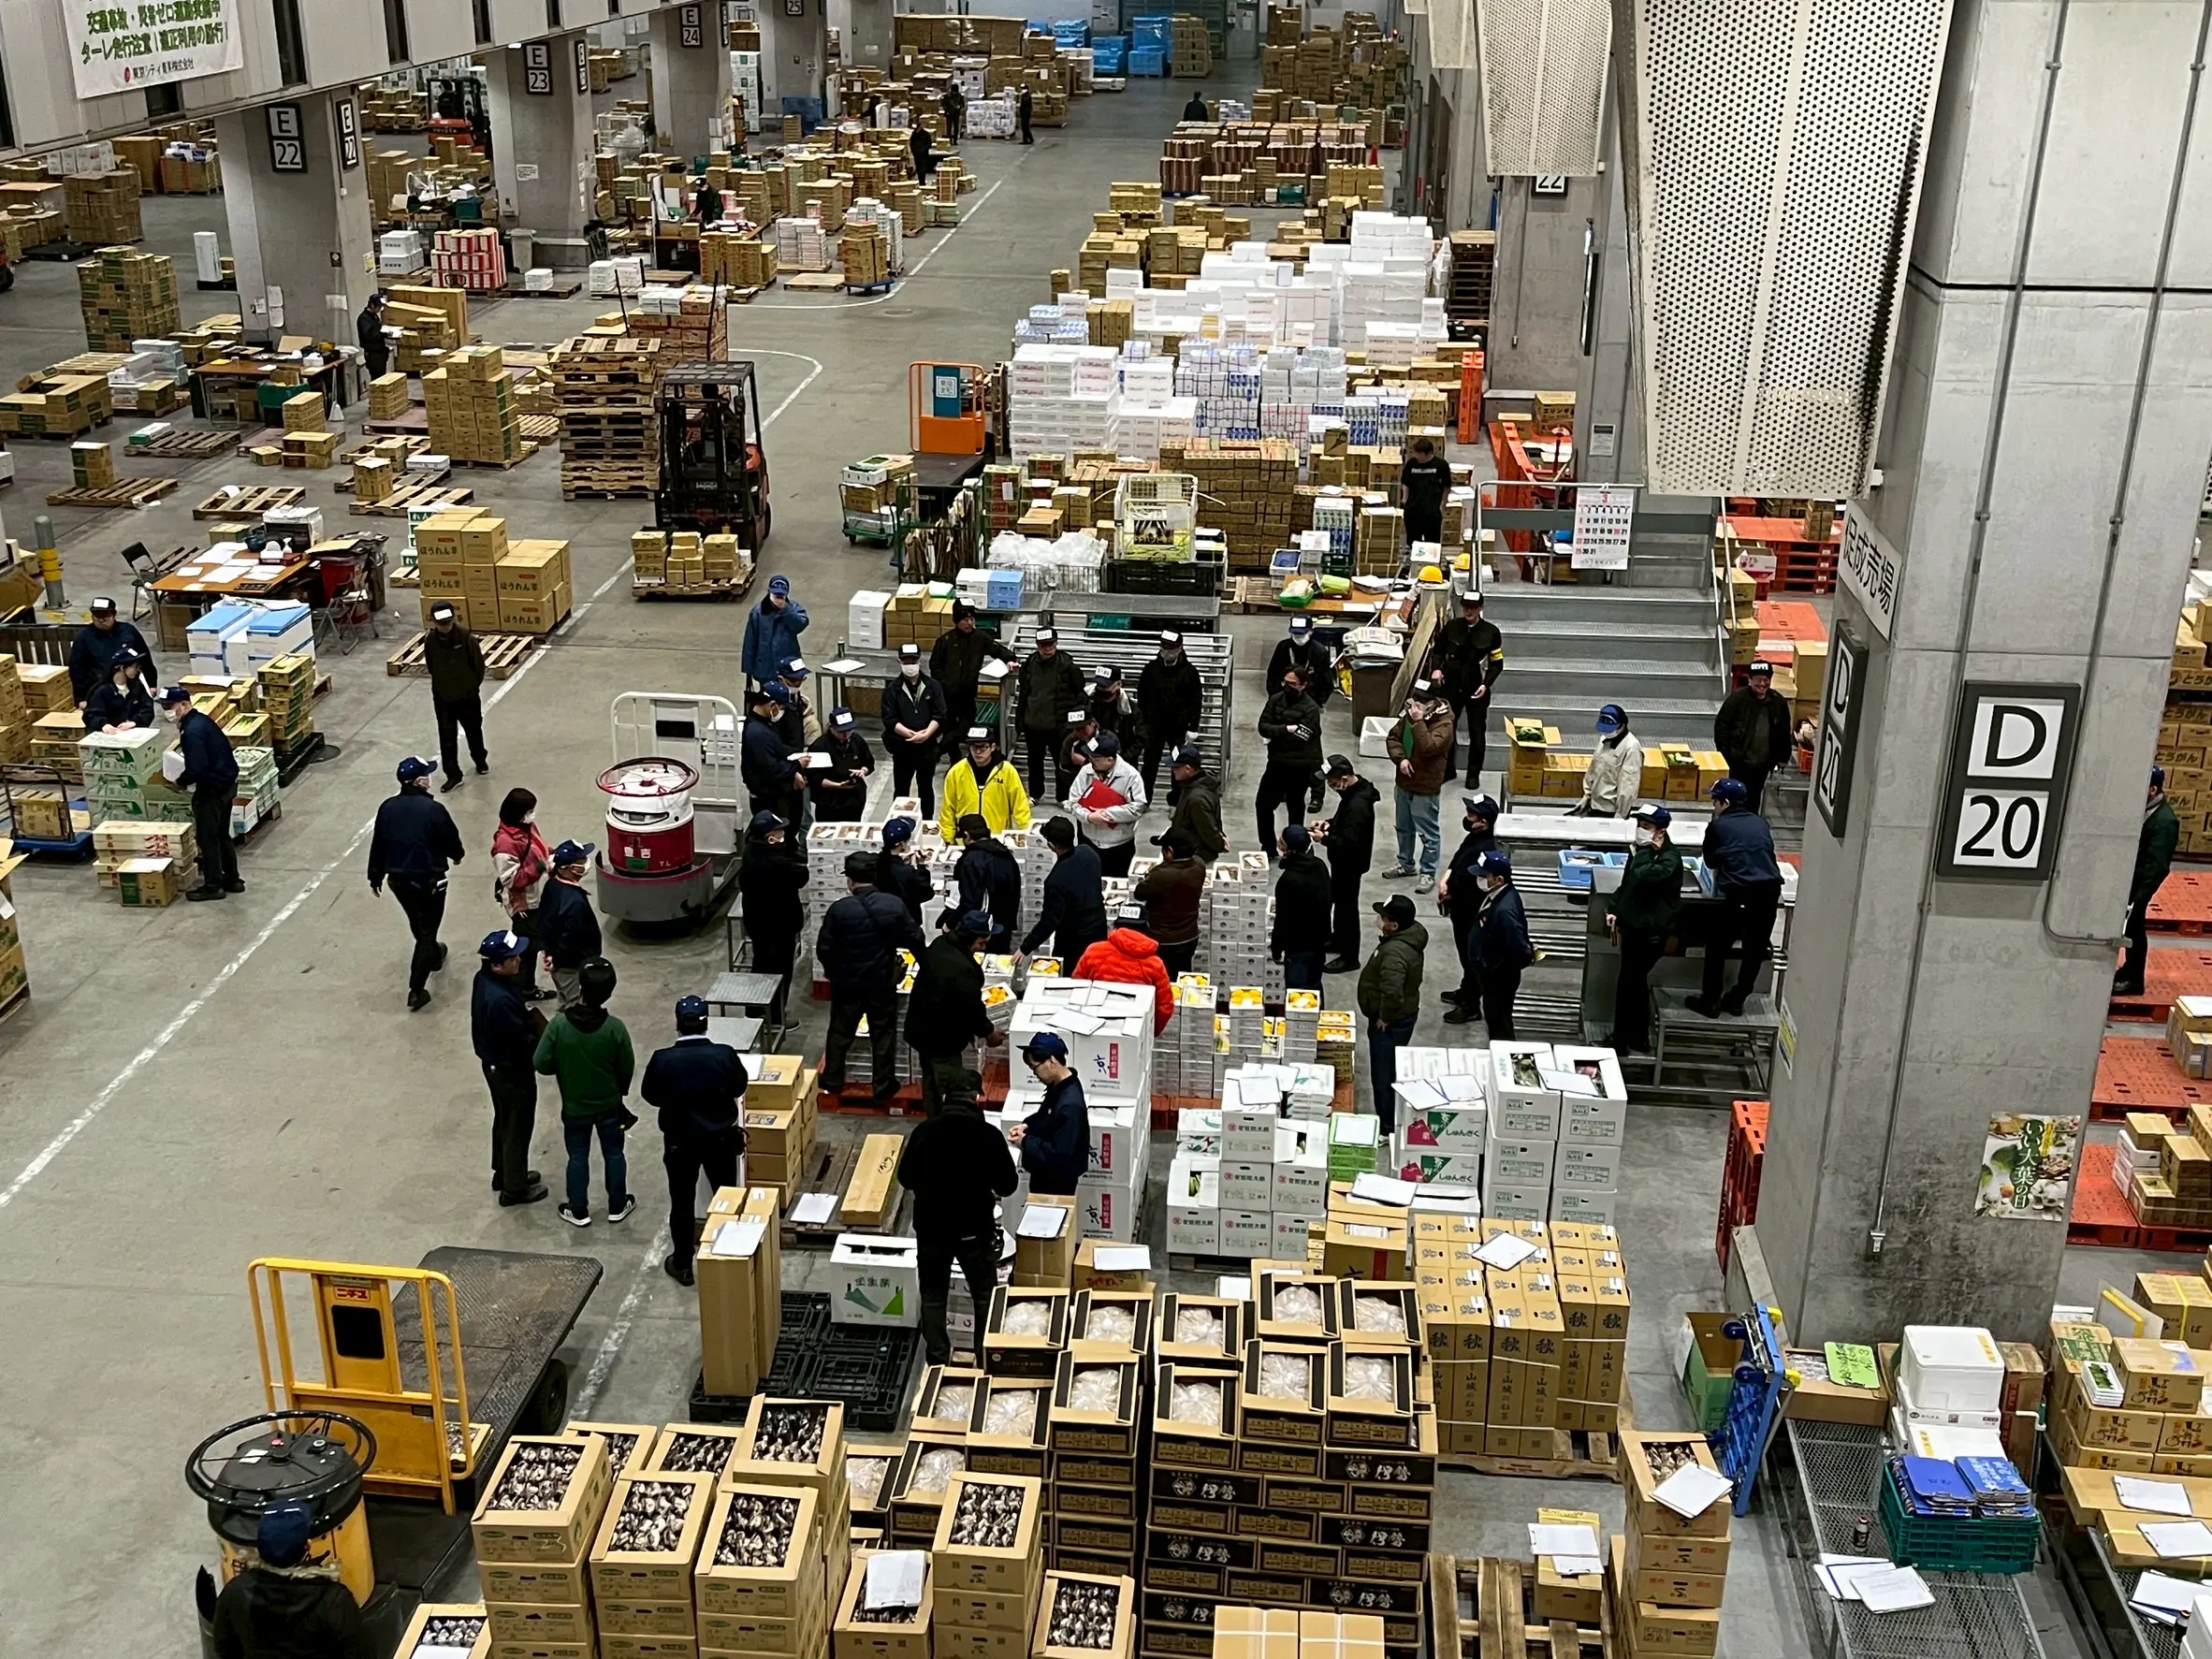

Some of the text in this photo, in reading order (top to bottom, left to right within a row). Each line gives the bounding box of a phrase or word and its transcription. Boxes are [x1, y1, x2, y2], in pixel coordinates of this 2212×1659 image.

[685, 8, 695, 23] E
[684, 29, 699, 44] 24
[532, 48, 544, 65] E
[530, 71, 548, 90] 23
[277, 110, 292, 134] E
[276, 142, 300, 165] 22
[421, 546, 457, 555] ほうれん草
[424, 579, 460, 589] ほうれん草
[501, 582, 538, 591] ほうれん草
[503, 616, 541, 625] ほうれん草
[1834, 648, 1850, 714] D
[1985, 705, 2047, 767] D
[2155, 751, 2198, 764] とうがん
[1822, 732, 1841, 808] 20
[1960, 794, 2041, 860] 20
[2014, 1122, 2044, 1208] いい大葉の日
[337, 1288, 368, 1299] ニチユ
